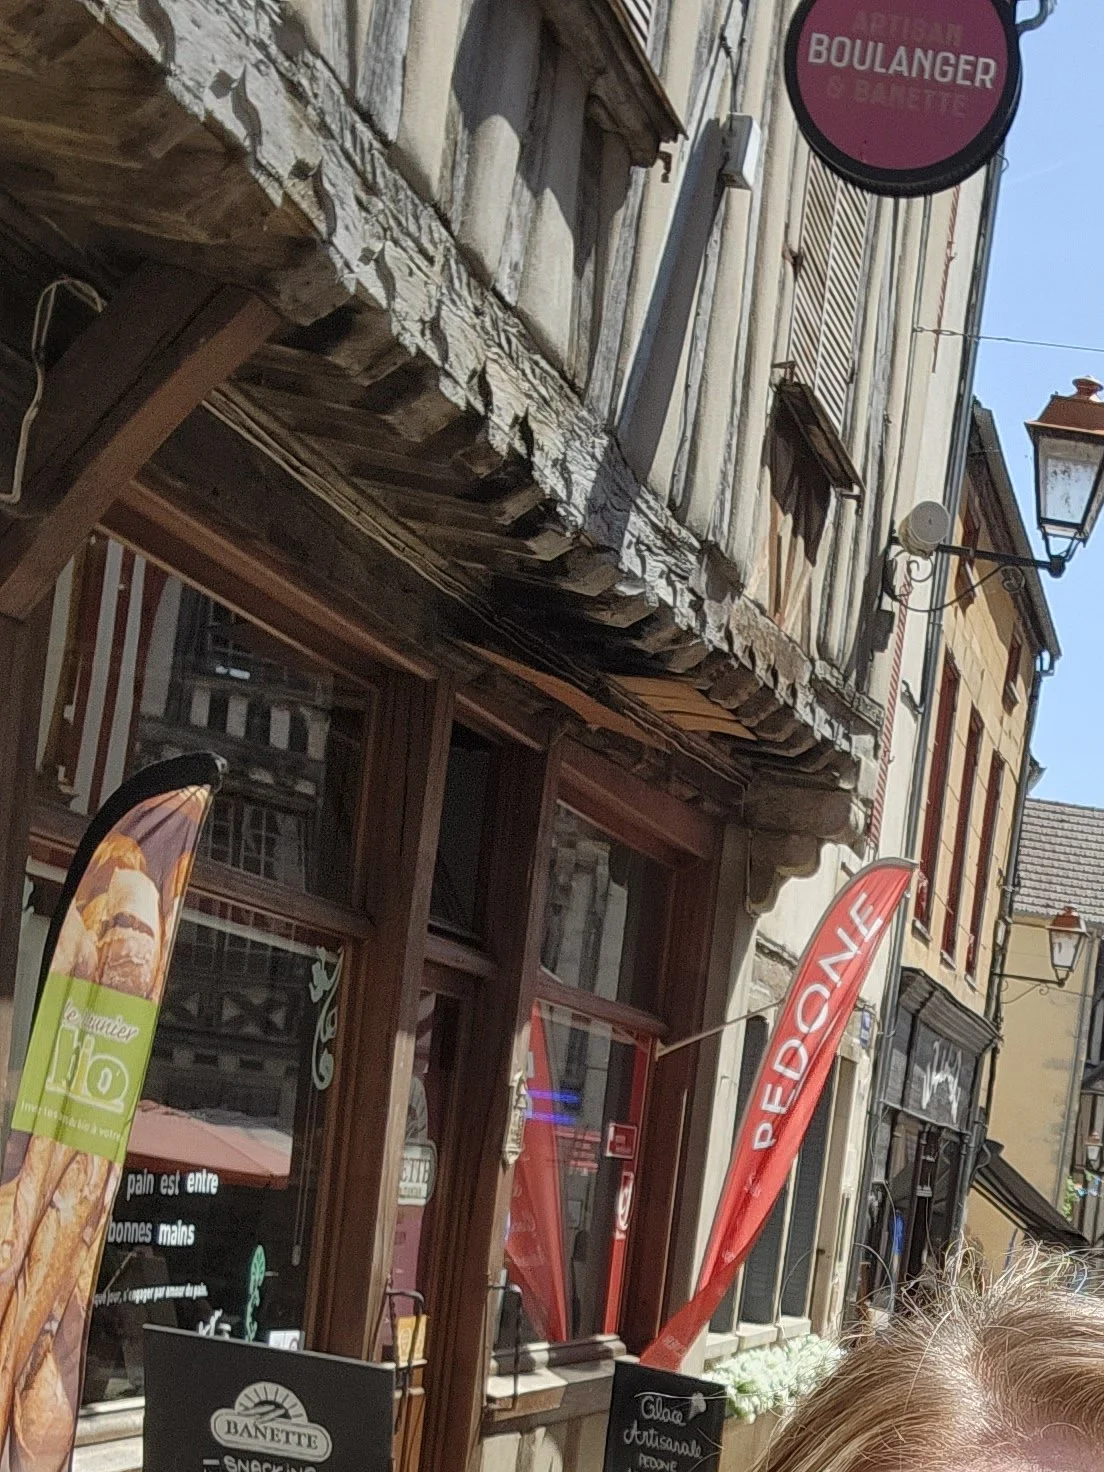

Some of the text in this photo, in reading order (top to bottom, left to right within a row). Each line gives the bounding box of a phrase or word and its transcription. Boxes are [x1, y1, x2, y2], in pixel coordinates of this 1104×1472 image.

[807, 32, 997, 90] BOULANGER
[752, 892, 882, 1151] PEDONE
[127, 1168, 219, 1202] pain est entre
[108, 1217, 195, 1246] bonnes mains
[641, 1395, 686, 1427] Glace
[225, 1419, 319, 1450] BANETTE
[624, 1419, 703, 1459] Artisanale
